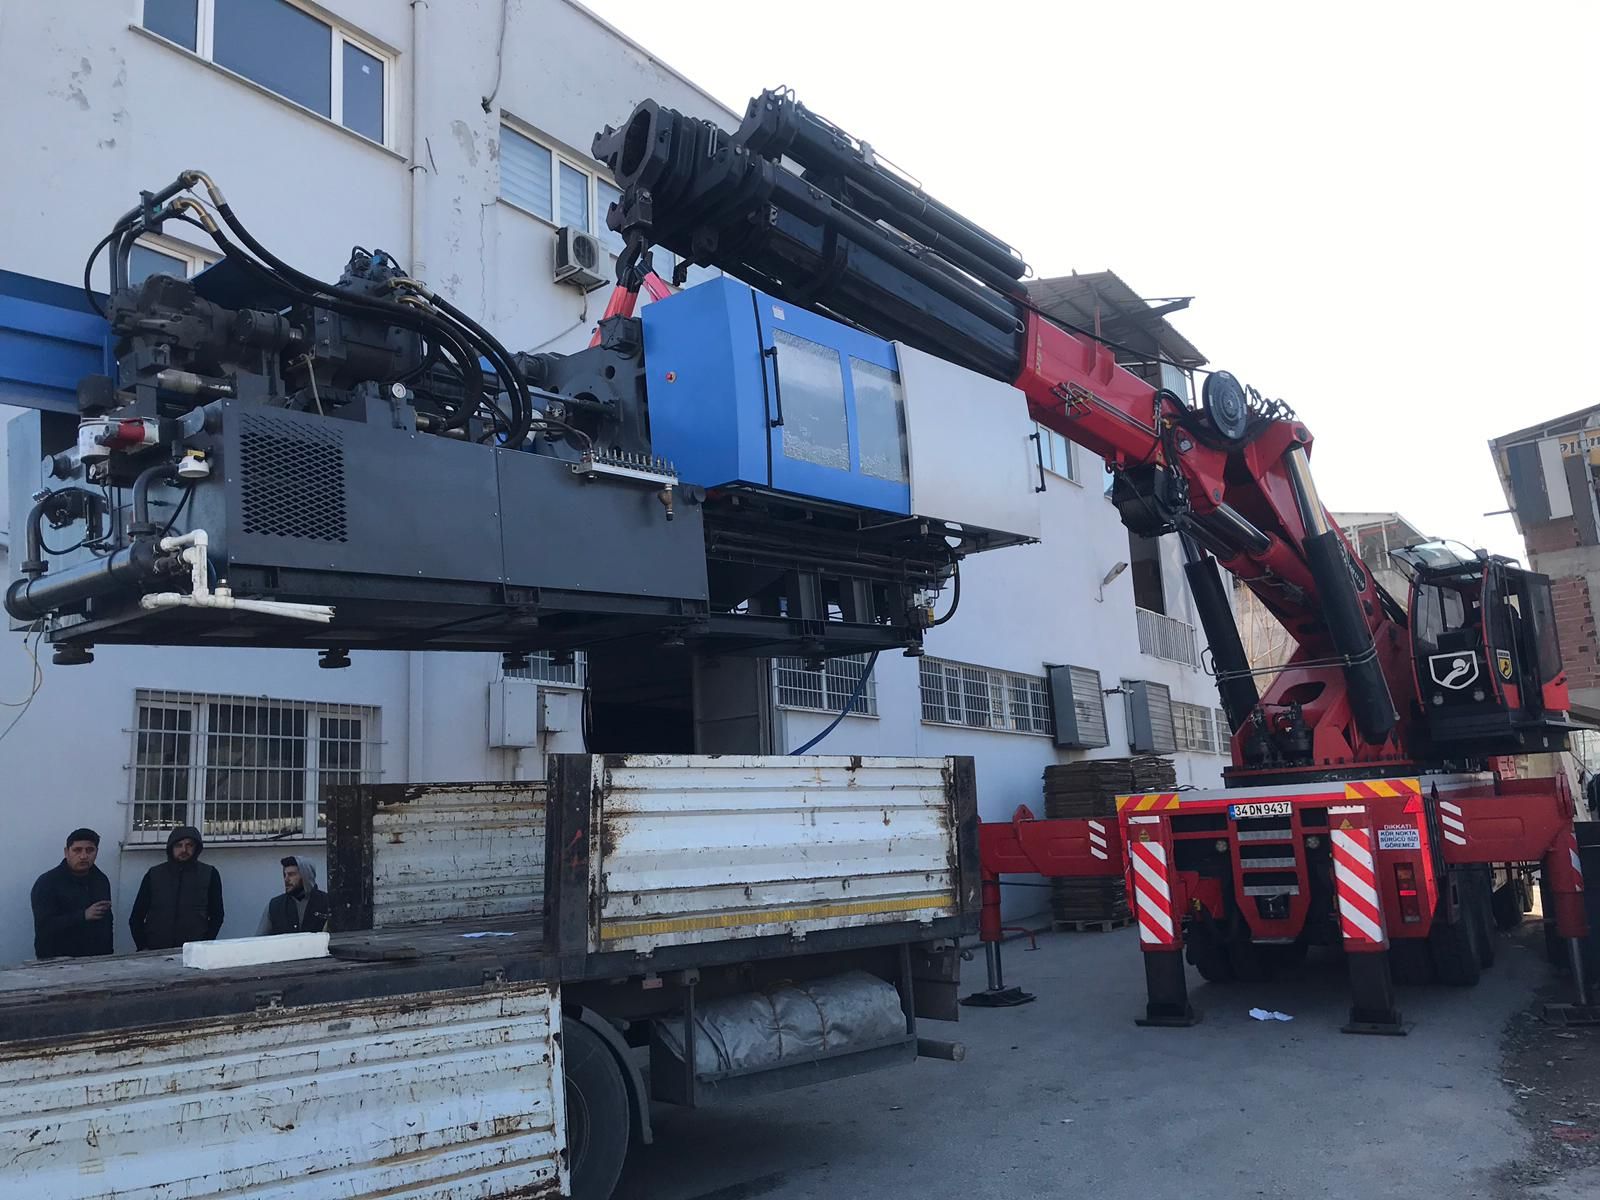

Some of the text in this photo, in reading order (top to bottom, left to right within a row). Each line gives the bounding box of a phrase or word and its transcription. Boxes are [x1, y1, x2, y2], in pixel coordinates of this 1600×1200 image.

[1235, 805, 1248, 816] 34
[1249, 804, 1262, 815] DN
[1263, 803, 1289, 814] 9437
